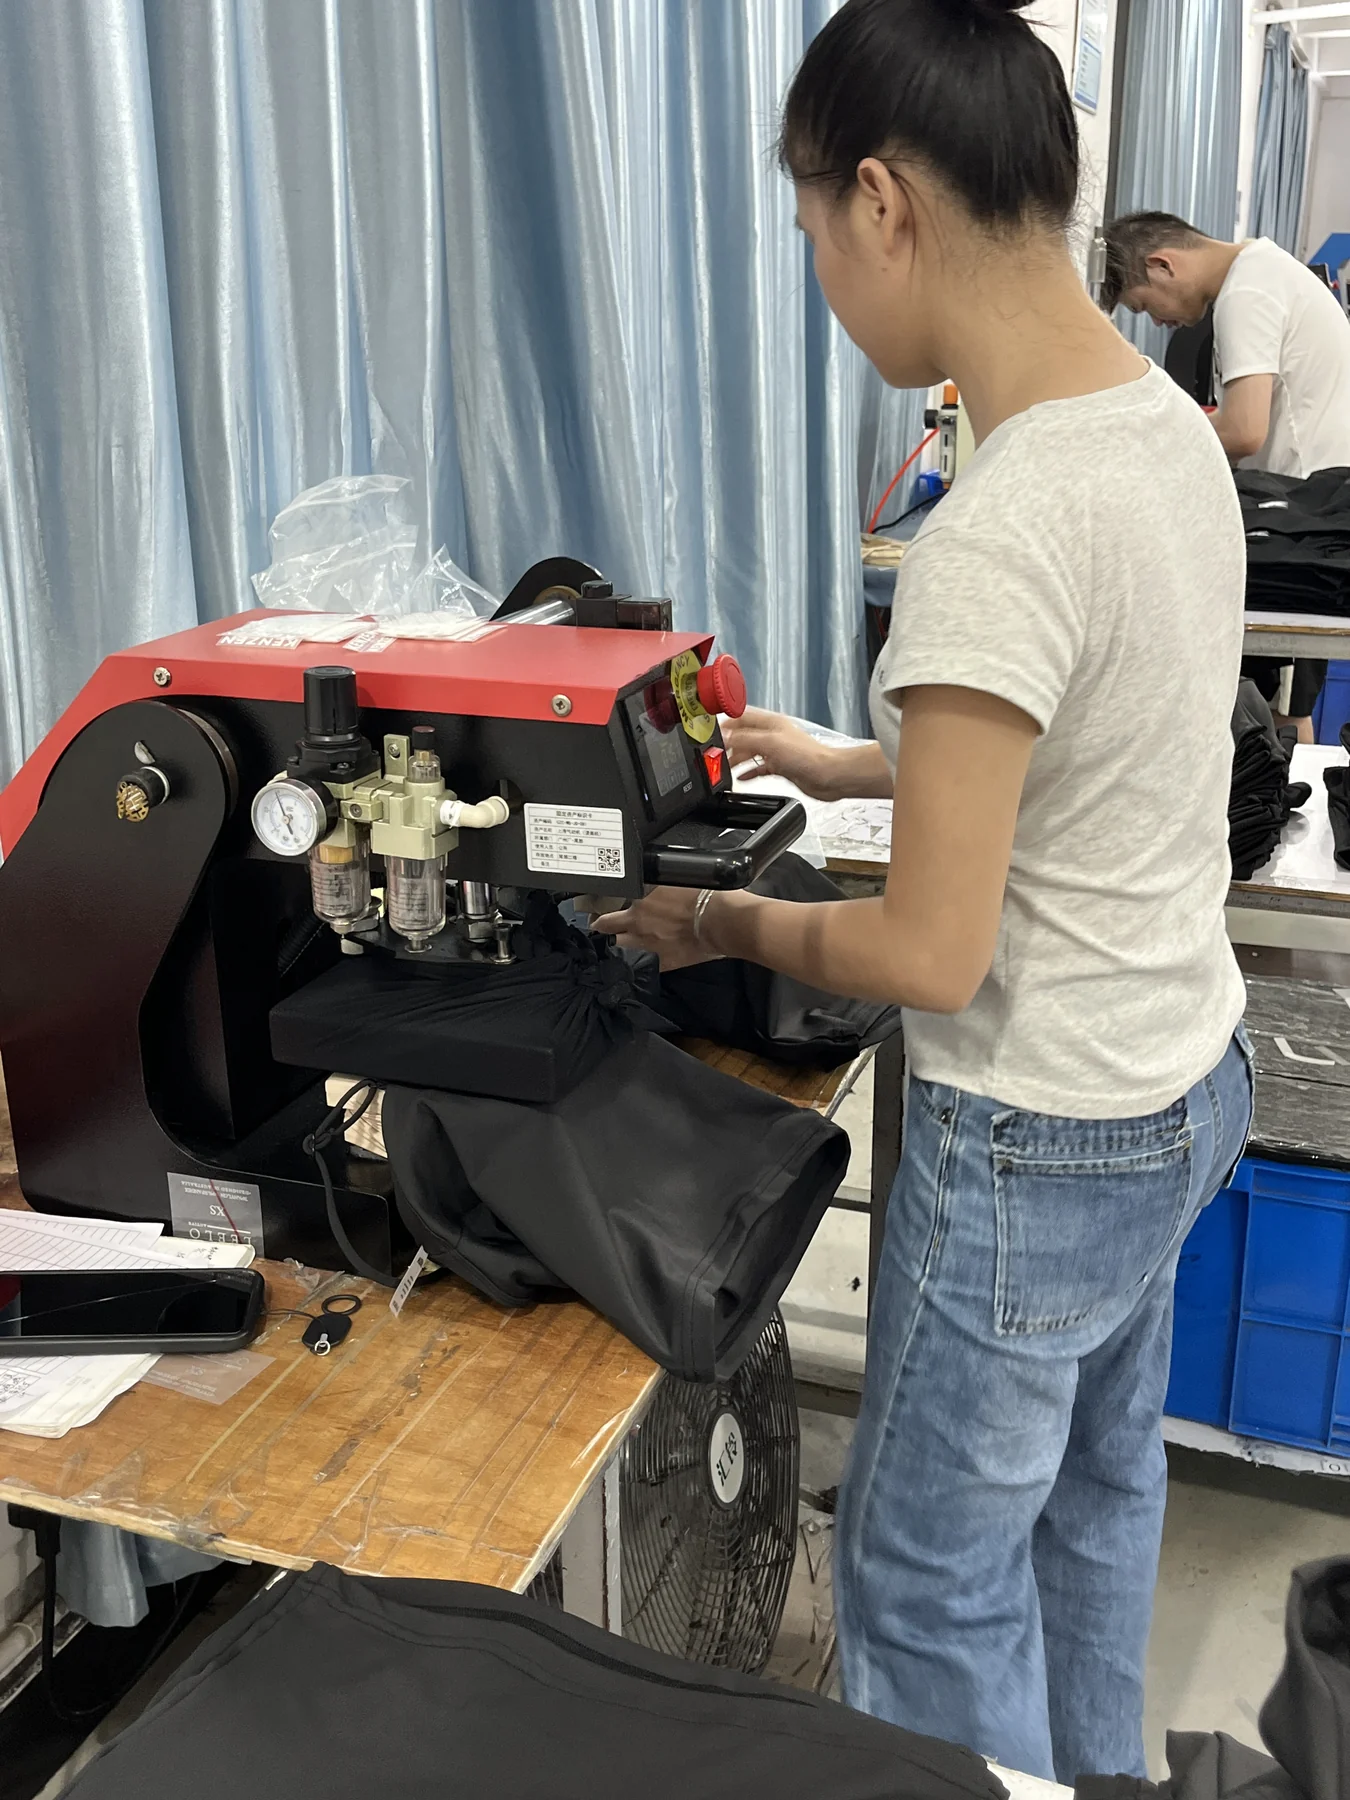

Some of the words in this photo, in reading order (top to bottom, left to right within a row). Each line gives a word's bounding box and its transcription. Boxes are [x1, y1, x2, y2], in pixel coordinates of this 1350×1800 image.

[220, 635, 298, 648] KENZEN
[209, 1204, 225, 1217] XS
[189, 1227, 252, 1246] LEELO
